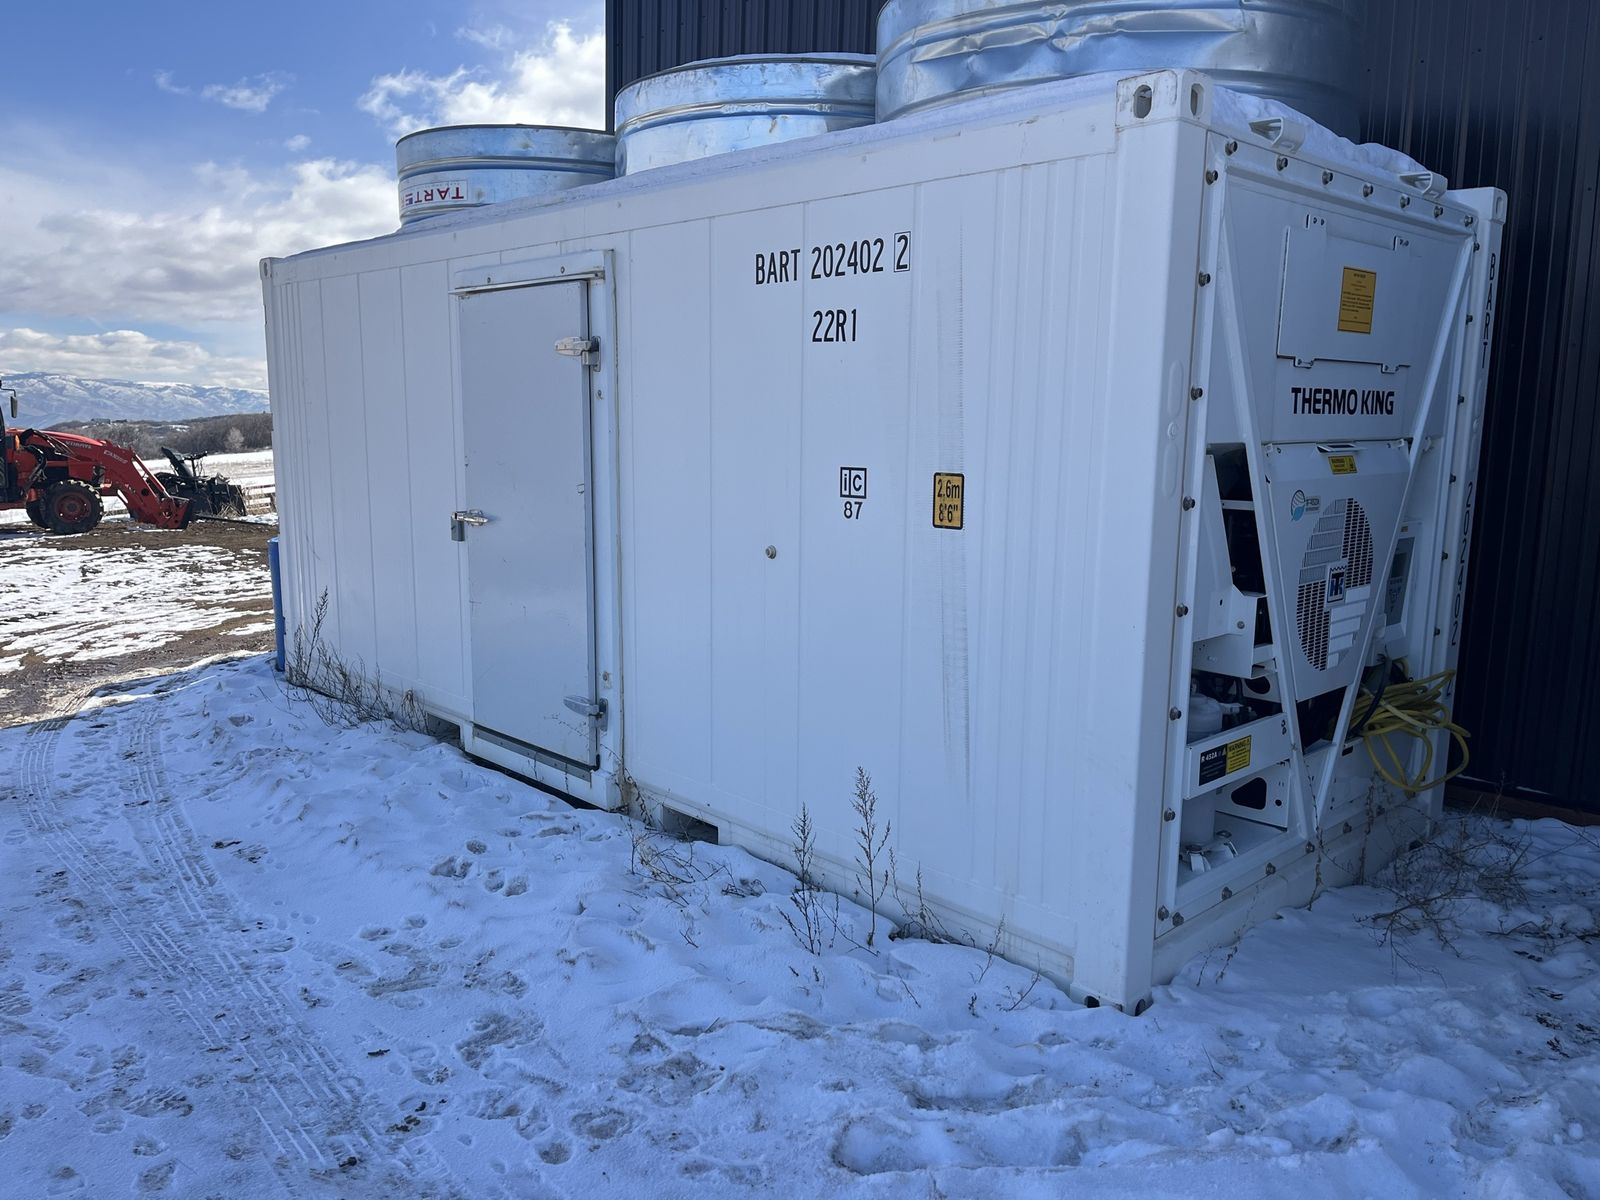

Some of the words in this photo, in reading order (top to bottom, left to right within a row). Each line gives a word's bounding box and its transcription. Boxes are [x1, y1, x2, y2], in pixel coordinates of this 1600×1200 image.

[755, 248, 801, 285] BART
[811, 237, 885, 280] 202402
[896, 234, 909, 270] 2
[812, 308, 857, 343] 22R1
[1482, 252, 1496, 369] BART
[1291, 387, 1358, 415] THERMO
[1361, 389, 1395, 416] KING
[937, 478, 961, 499] 2.6m
[843, 501, 863, 520] 87
[1451, 481, 1473, 647] 202402
